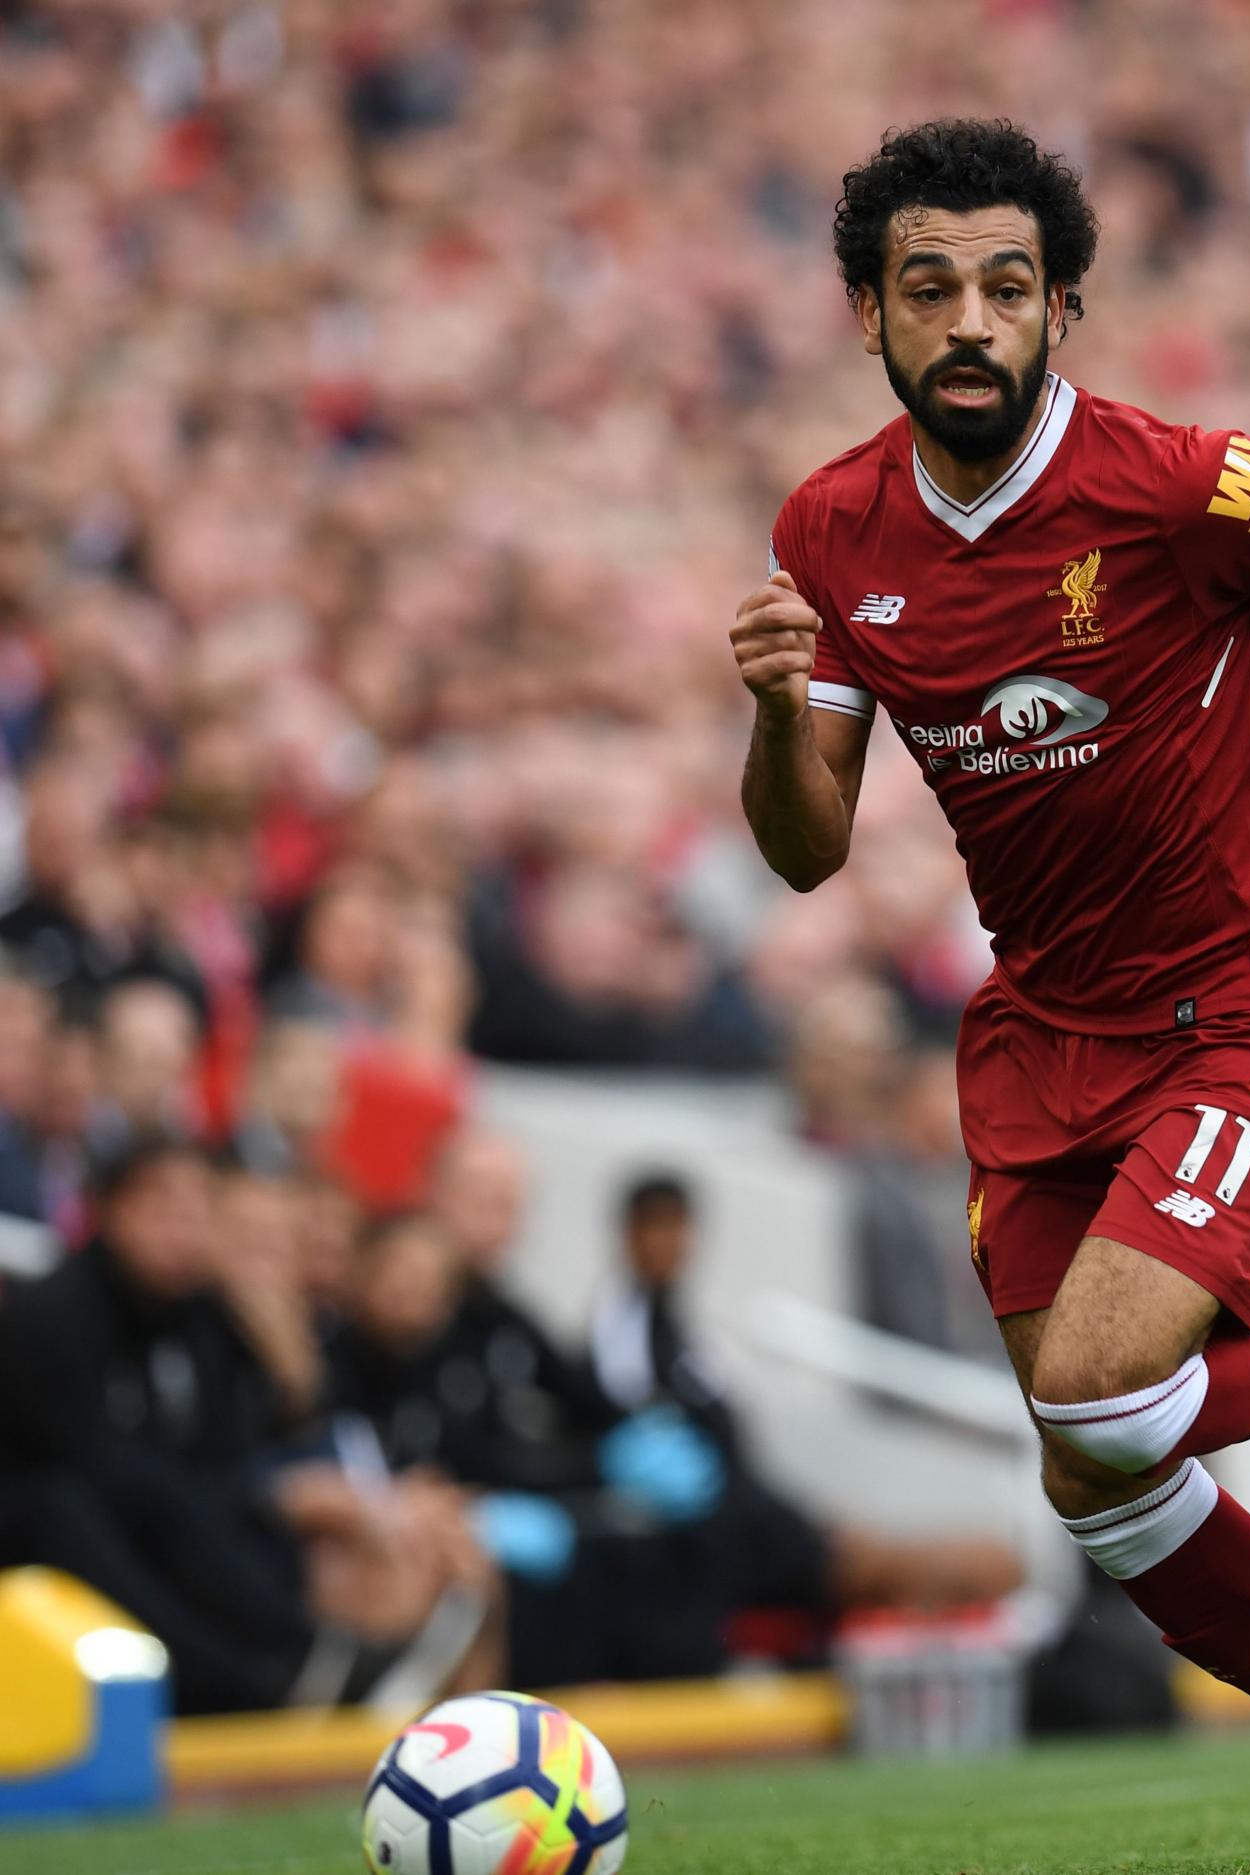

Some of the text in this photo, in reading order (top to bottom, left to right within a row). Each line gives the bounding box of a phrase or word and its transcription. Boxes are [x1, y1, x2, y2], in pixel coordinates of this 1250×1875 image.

[1063, 634, 1105, 647] 125 YEARS
[893, 718, 985, 747] eeing
